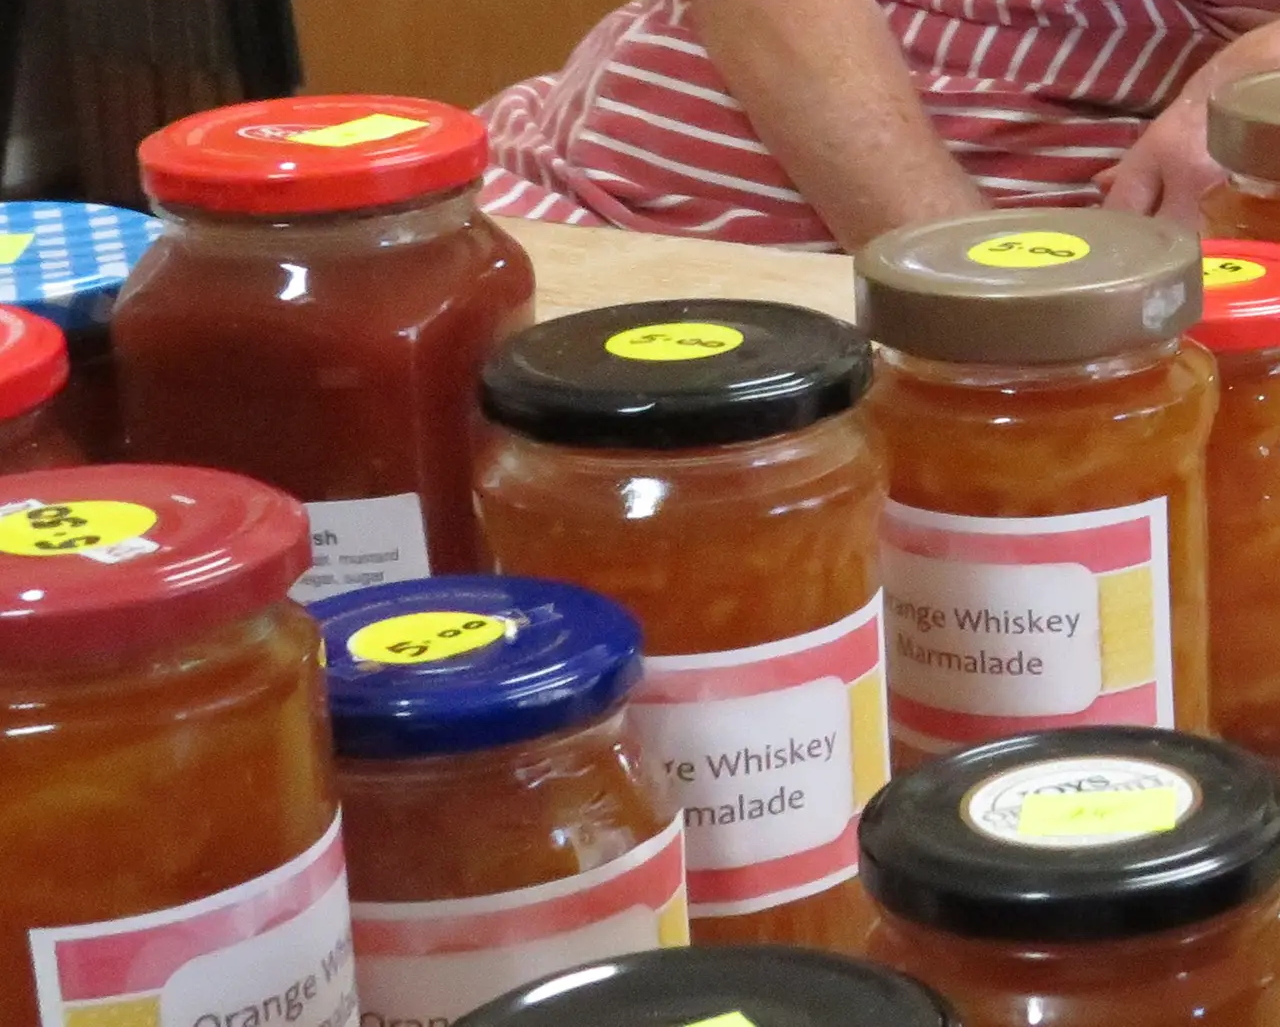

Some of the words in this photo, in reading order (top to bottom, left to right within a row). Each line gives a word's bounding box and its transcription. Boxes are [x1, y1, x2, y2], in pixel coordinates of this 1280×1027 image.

[988, 241, 1076, 258] 5.00
[629, 333, 727, 349] 5.00
[386, 619, 488, 658] 5.00
[953, 607, 1080, 638] Whiskey
[897, 633, 1044, 676] Marmalade
[706, 731, 837, 780] Whiskey
[683, 786, 805, 827] malade
